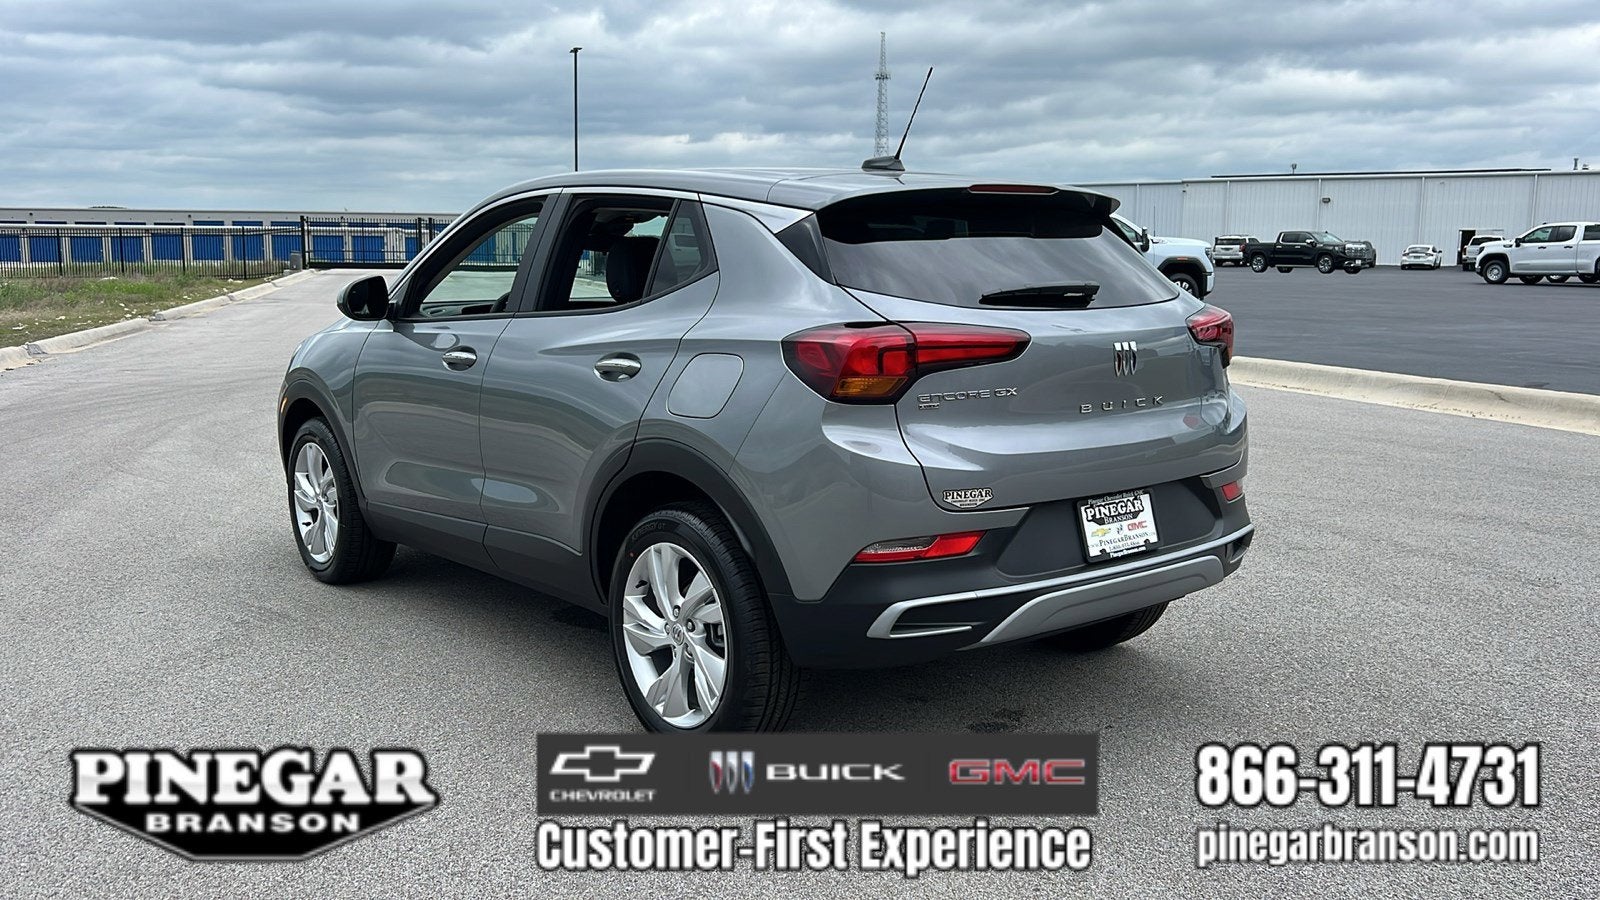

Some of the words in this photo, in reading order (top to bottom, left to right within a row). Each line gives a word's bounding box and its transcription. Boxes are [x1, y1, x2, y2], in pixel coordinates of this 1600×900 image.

[918, 390, 991, 402] ENCORE
[994, 387, 1018, 397] GX
[1080, 395, 1163, 413] BUICK
[944, 489, 992, 500] PINEGAR
[1086, 499, 1144, 521] PINEGAR
[1104, 513, 1133, 524] BRANSON
[1127, 520, 1148, 531] GMC
